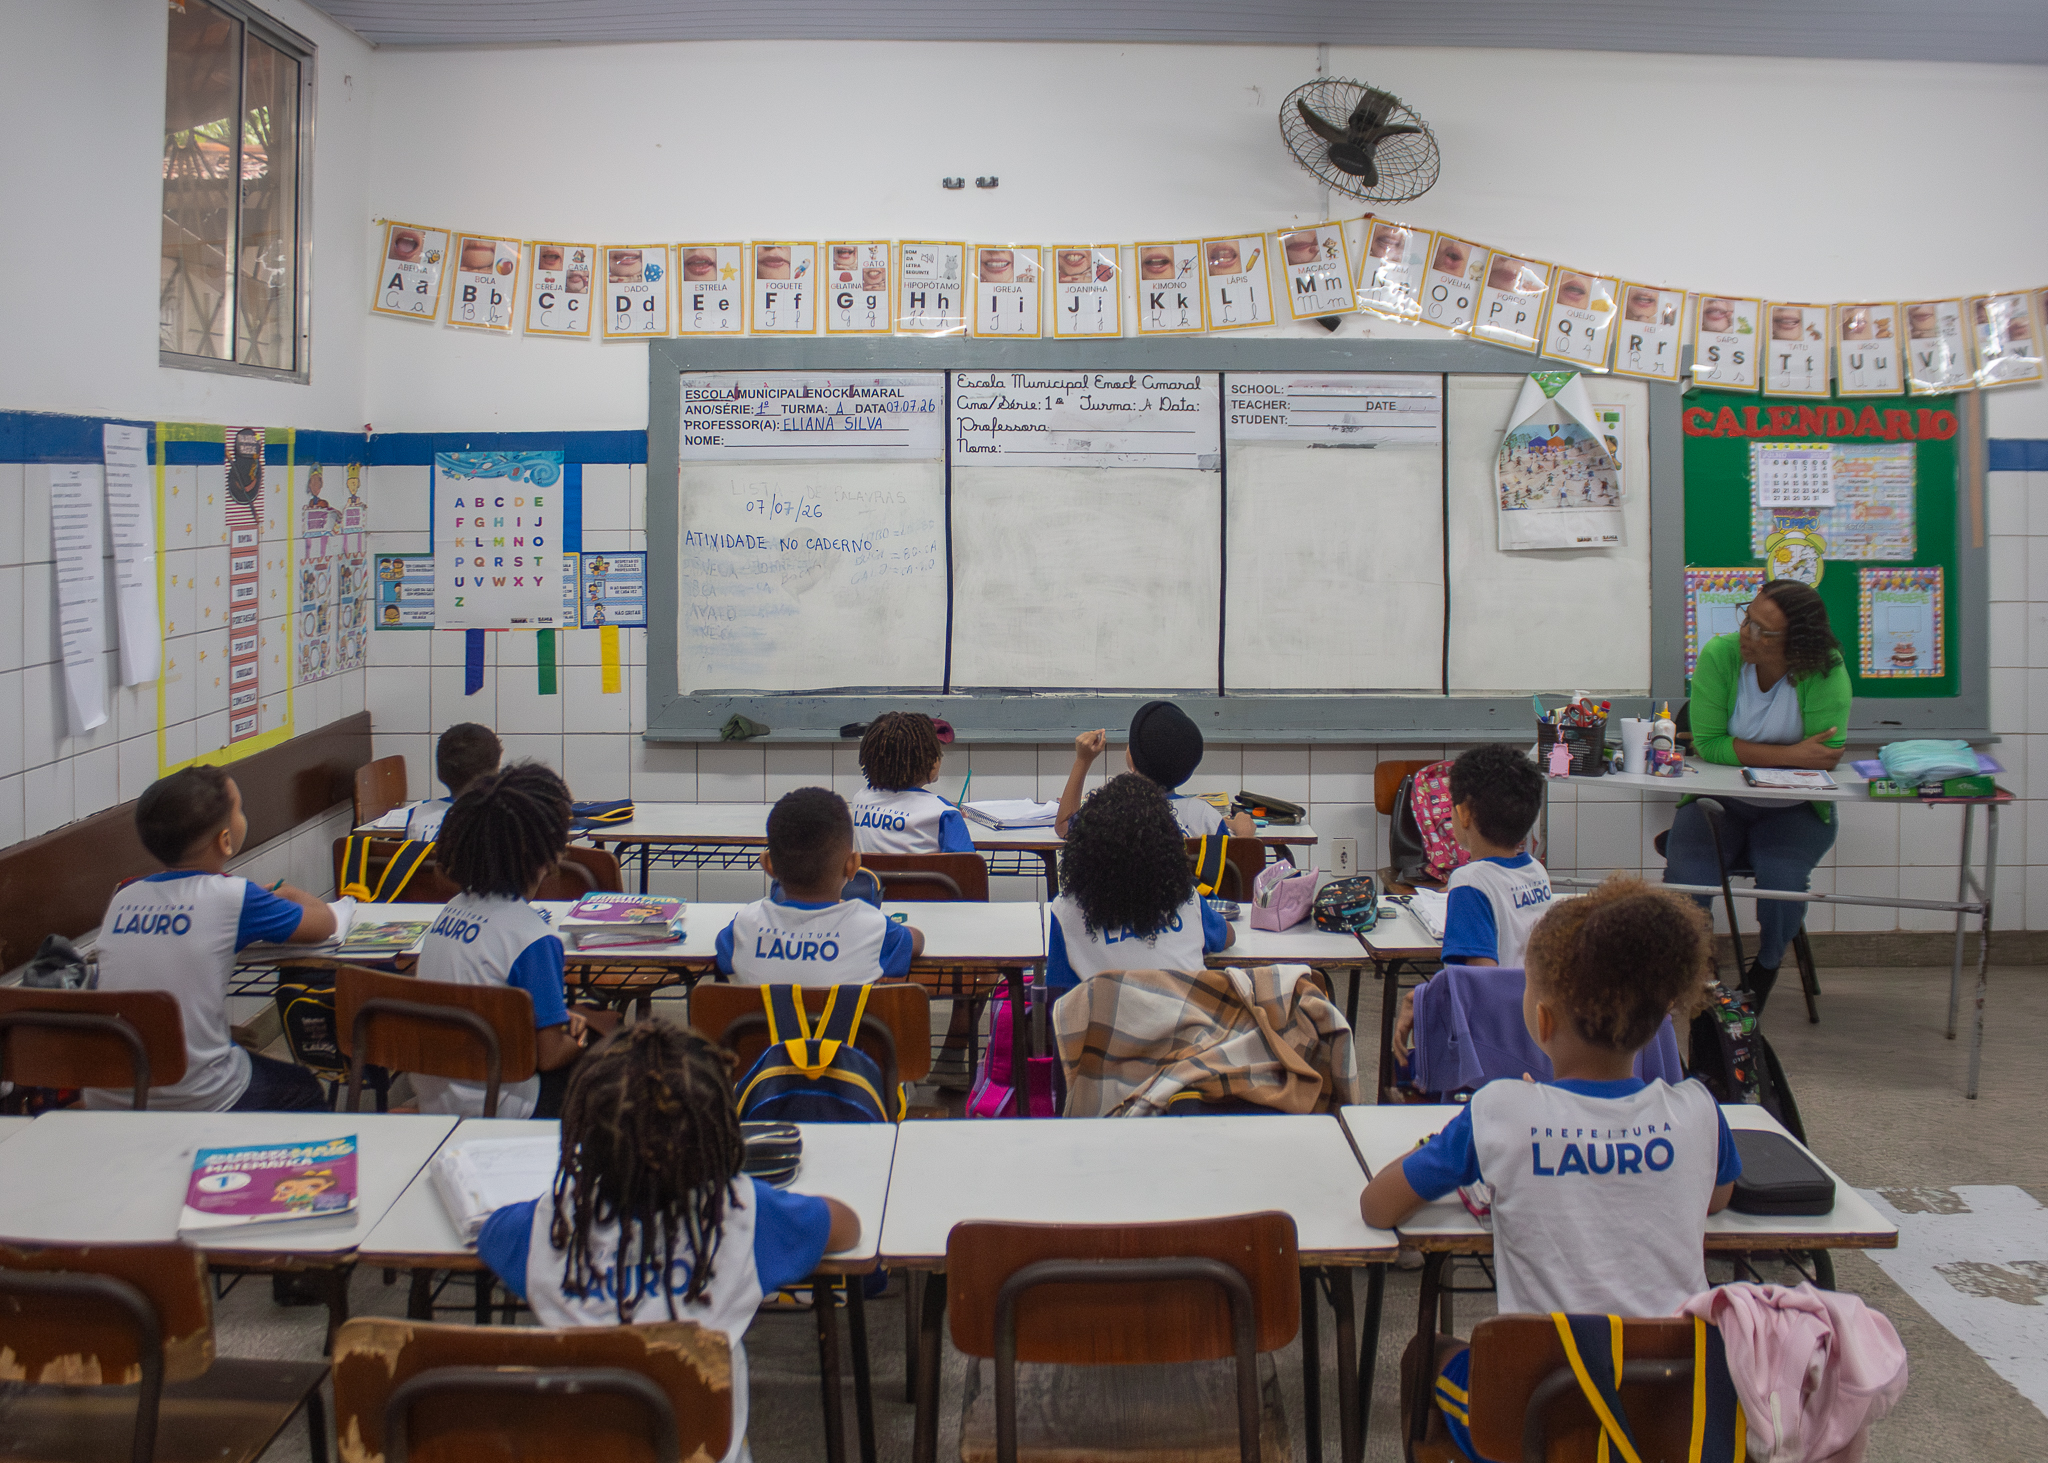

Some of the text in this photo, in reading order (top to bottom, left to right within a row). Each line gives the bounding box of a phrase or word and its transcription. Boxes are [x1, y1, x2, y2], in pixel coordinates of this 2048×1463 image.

[863, 260, 884, 268] GATO
[1298, 263, 1336, 274] MACACO
[388, 273, 428, 294] A a
[475, 276, 496, 285] BOLA
[535, 283, 563, 292] CEREJA
[904, 281, 960, 290] HIPOPÓTAMO
[1152, 282, 1186, 290] KIMONO
[1227, 275, 1248, 284] LÁPIS
[1296, 276, 1342, 294] M m
[1440, 276, 1471, 290] OVELHA
[463, 285, 502, 305] B b
[1065, 286, 1108, 294] JOANINHA
[1221, 288, 1232, 304] L
[1432, 285, 1468, 309] O o
[539, 293, 578, 311] C c
[616, 296, 654, 312] D d
[694, 294, 729, 310] E e
[766, 293, 801, 309] F f
[837, 292, 876, 309] G g
[911, 292, 949, 309] H h
[992, 296, 997, 312] I
[1068, 296, 1079, 313] J
[1151, 292, 1188, 309] K k
[1498, 292, 1526, 306] PORCO
[1490, 302, 1526, 323] P p
[1566, 309, 1596, 321] QUEIJO
[1558, 320, 1595, 341] Q q
[1630, 335, 1667, 354] R r
[1716, 336, 1738, 344] SAPO
[1708, 346, 1744, 364] S s
[1779, 354, 1813, 371] T t
[1850, 354, 1887, 370] U u
[1919, 351, 1933, 368] V
[957, 374, 1200, 396] Escola Municipal Enock Amaral
[1232, 384, 1284, 394] SCHOOL:
[685, 388, 904, 399] ESCOLA MUNICIPAL ENOCK AMARAL
[685, 402, 754, 414] ANO/SÉRIE:
[782, 404, 828, 414] TURMA:
[836, 402, 844, 415] A
[856, 404, 886, 414] DATA
[957, 395, 1041, 410] Ano/Série:
[1080, 395, 1136, 412] Turma:
[1159, 396, 1200, 412] Data:
[1232, 400, 1290, 410] TEACHER:
[684, 416, 883, 432] PROFESSOR(A): ELIANA SILVA
[1232, 415, 1288, 424] STUDENT:
[1682, 405, 1959, 440] CALENDARIO
[685, 435, 724, 446] NOME:
[957, 438, 1002, 454] Nome:
[455, 497, 543, 508] A B C D E
[746, 494, 822, 522] 07/07/26
[456, 517, 542, 527] F G H I J
[1776, 517, 1819, 530] TEMPO
[455, 537, 543, 547] K L M N O
[686, 530, 767, 552] ATIVIDADE
[780, 538, 798, 552] NO
[455, 557, 543, 567] P Q R S T
[455, 577, 543, 587] U V W X Y
[455, 597, 464, 607] Z
[854, 812, 905, 831] LAURO
[1513, 887, 1552, 909] LAURO
[113, 914, 192, 936] LAURO
[759, 927, 840, 938] PREFEITURA
[755, 936, 839, 962] LAURO
[1531, 1122, 1672, 1138] PREFEITURA
[1532, 1138, 1674, 1176] LAURO
